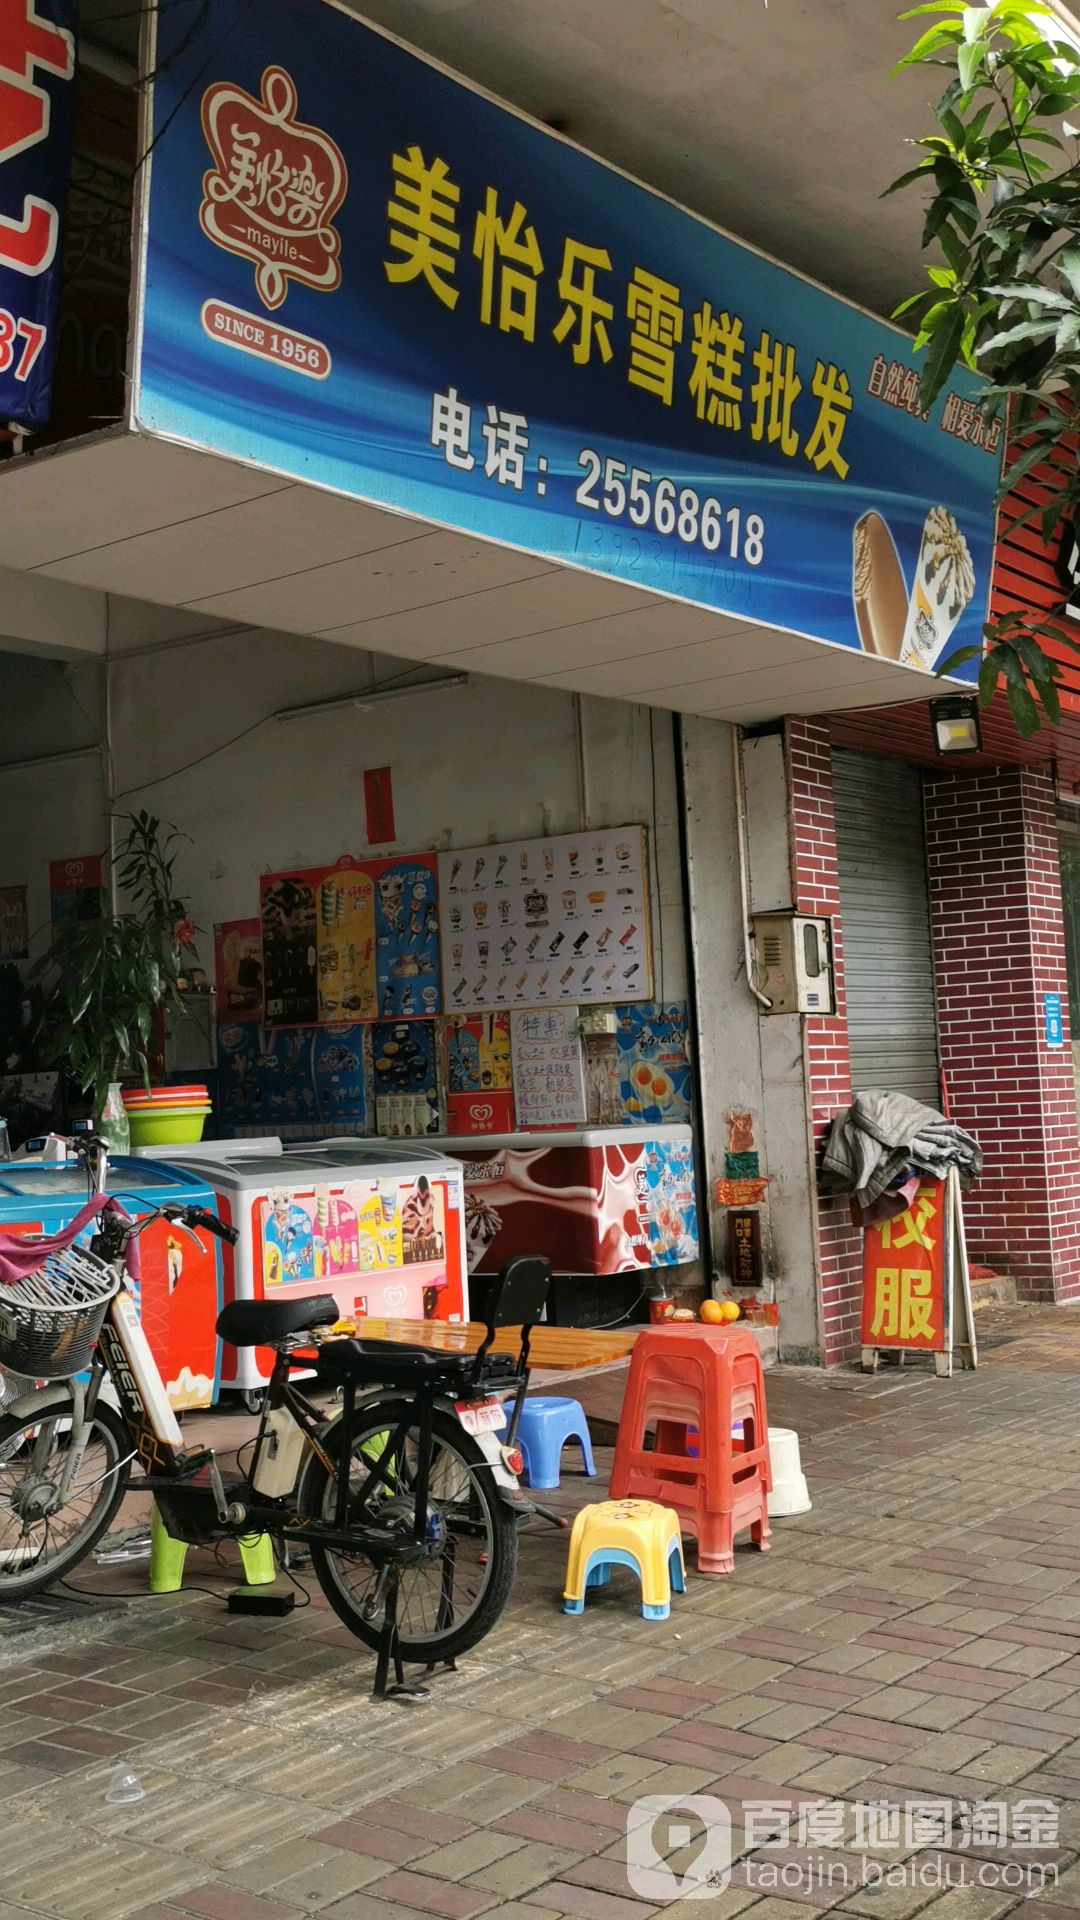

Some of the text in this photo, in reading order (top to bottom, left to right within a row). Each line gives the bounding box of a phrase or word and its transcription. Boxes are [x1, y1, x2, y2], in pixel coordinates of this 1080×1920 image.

[247, 227, 298, 260] mayile
[214, 312, 320, 368] SINCE 1956
[384, 146, 854, 480] 美怡乐雪糕批发
[867, 353, 930, 423] 自然纯
